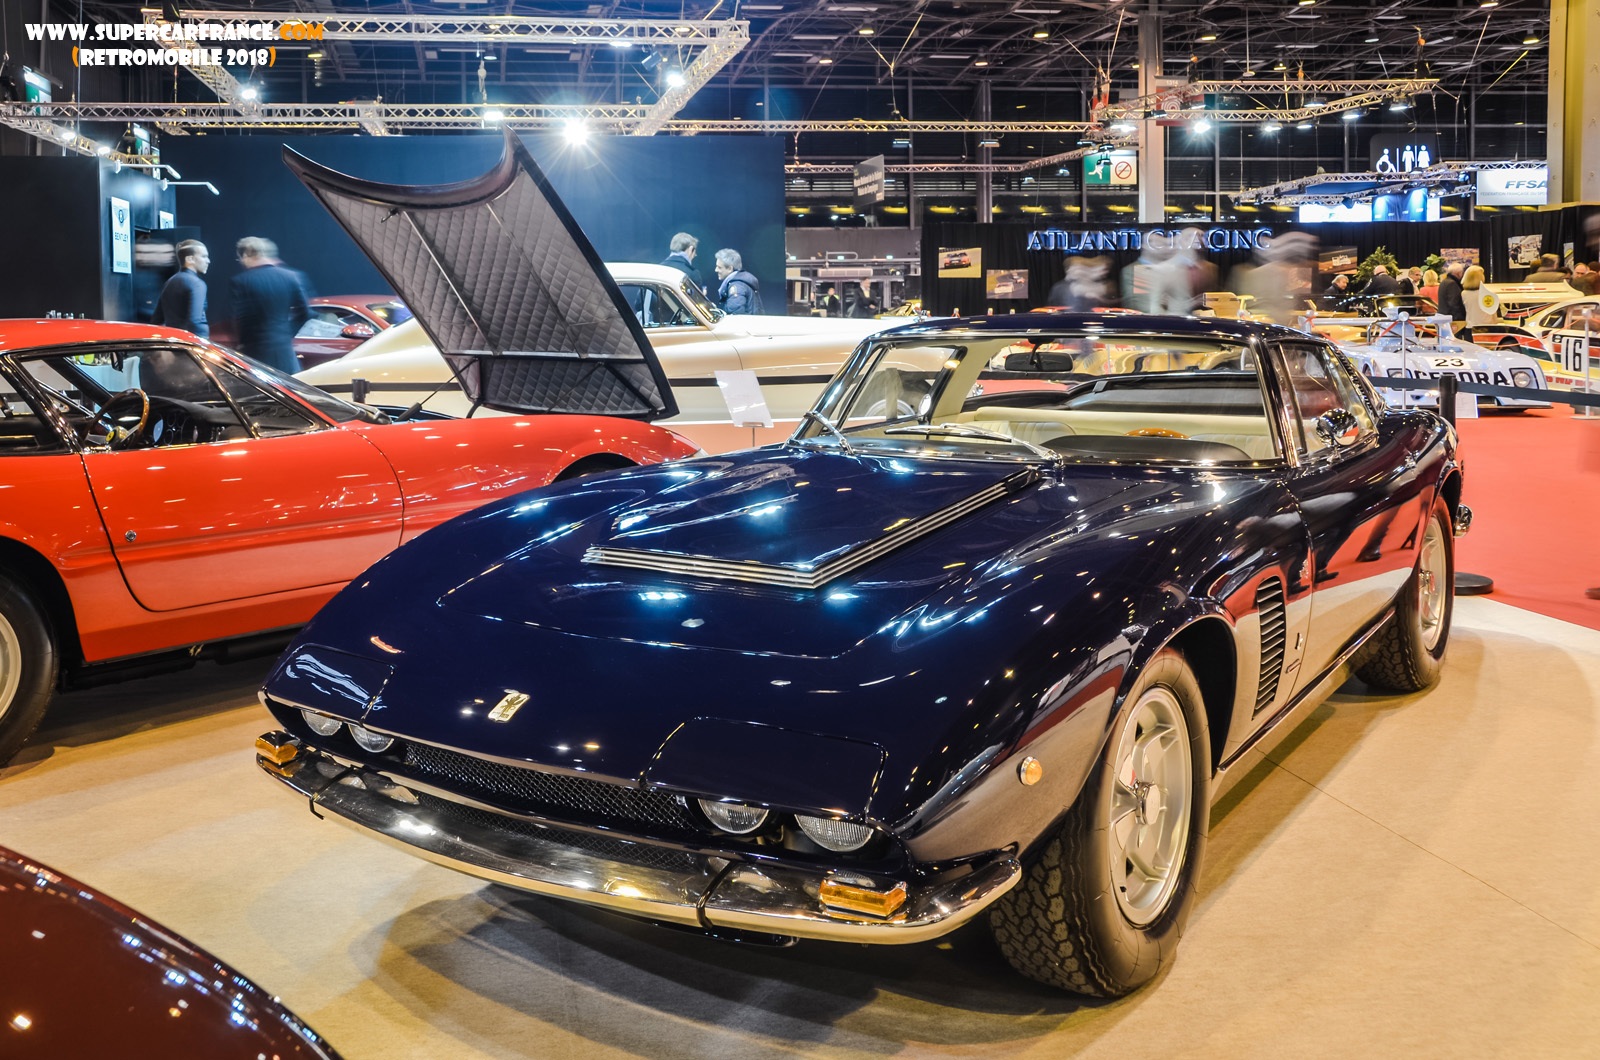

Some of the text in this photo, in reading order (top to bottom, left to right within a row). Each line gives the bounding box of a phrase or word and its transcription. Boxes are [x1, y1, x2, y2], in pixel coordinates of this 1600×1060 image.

[1505, 180, 1548, 189] FFSA
[1027, 229, 1165, 251] ATLANTIC
[1434, 358, 1464, 368] 23
[1565, 338, 1583, 372] 16
